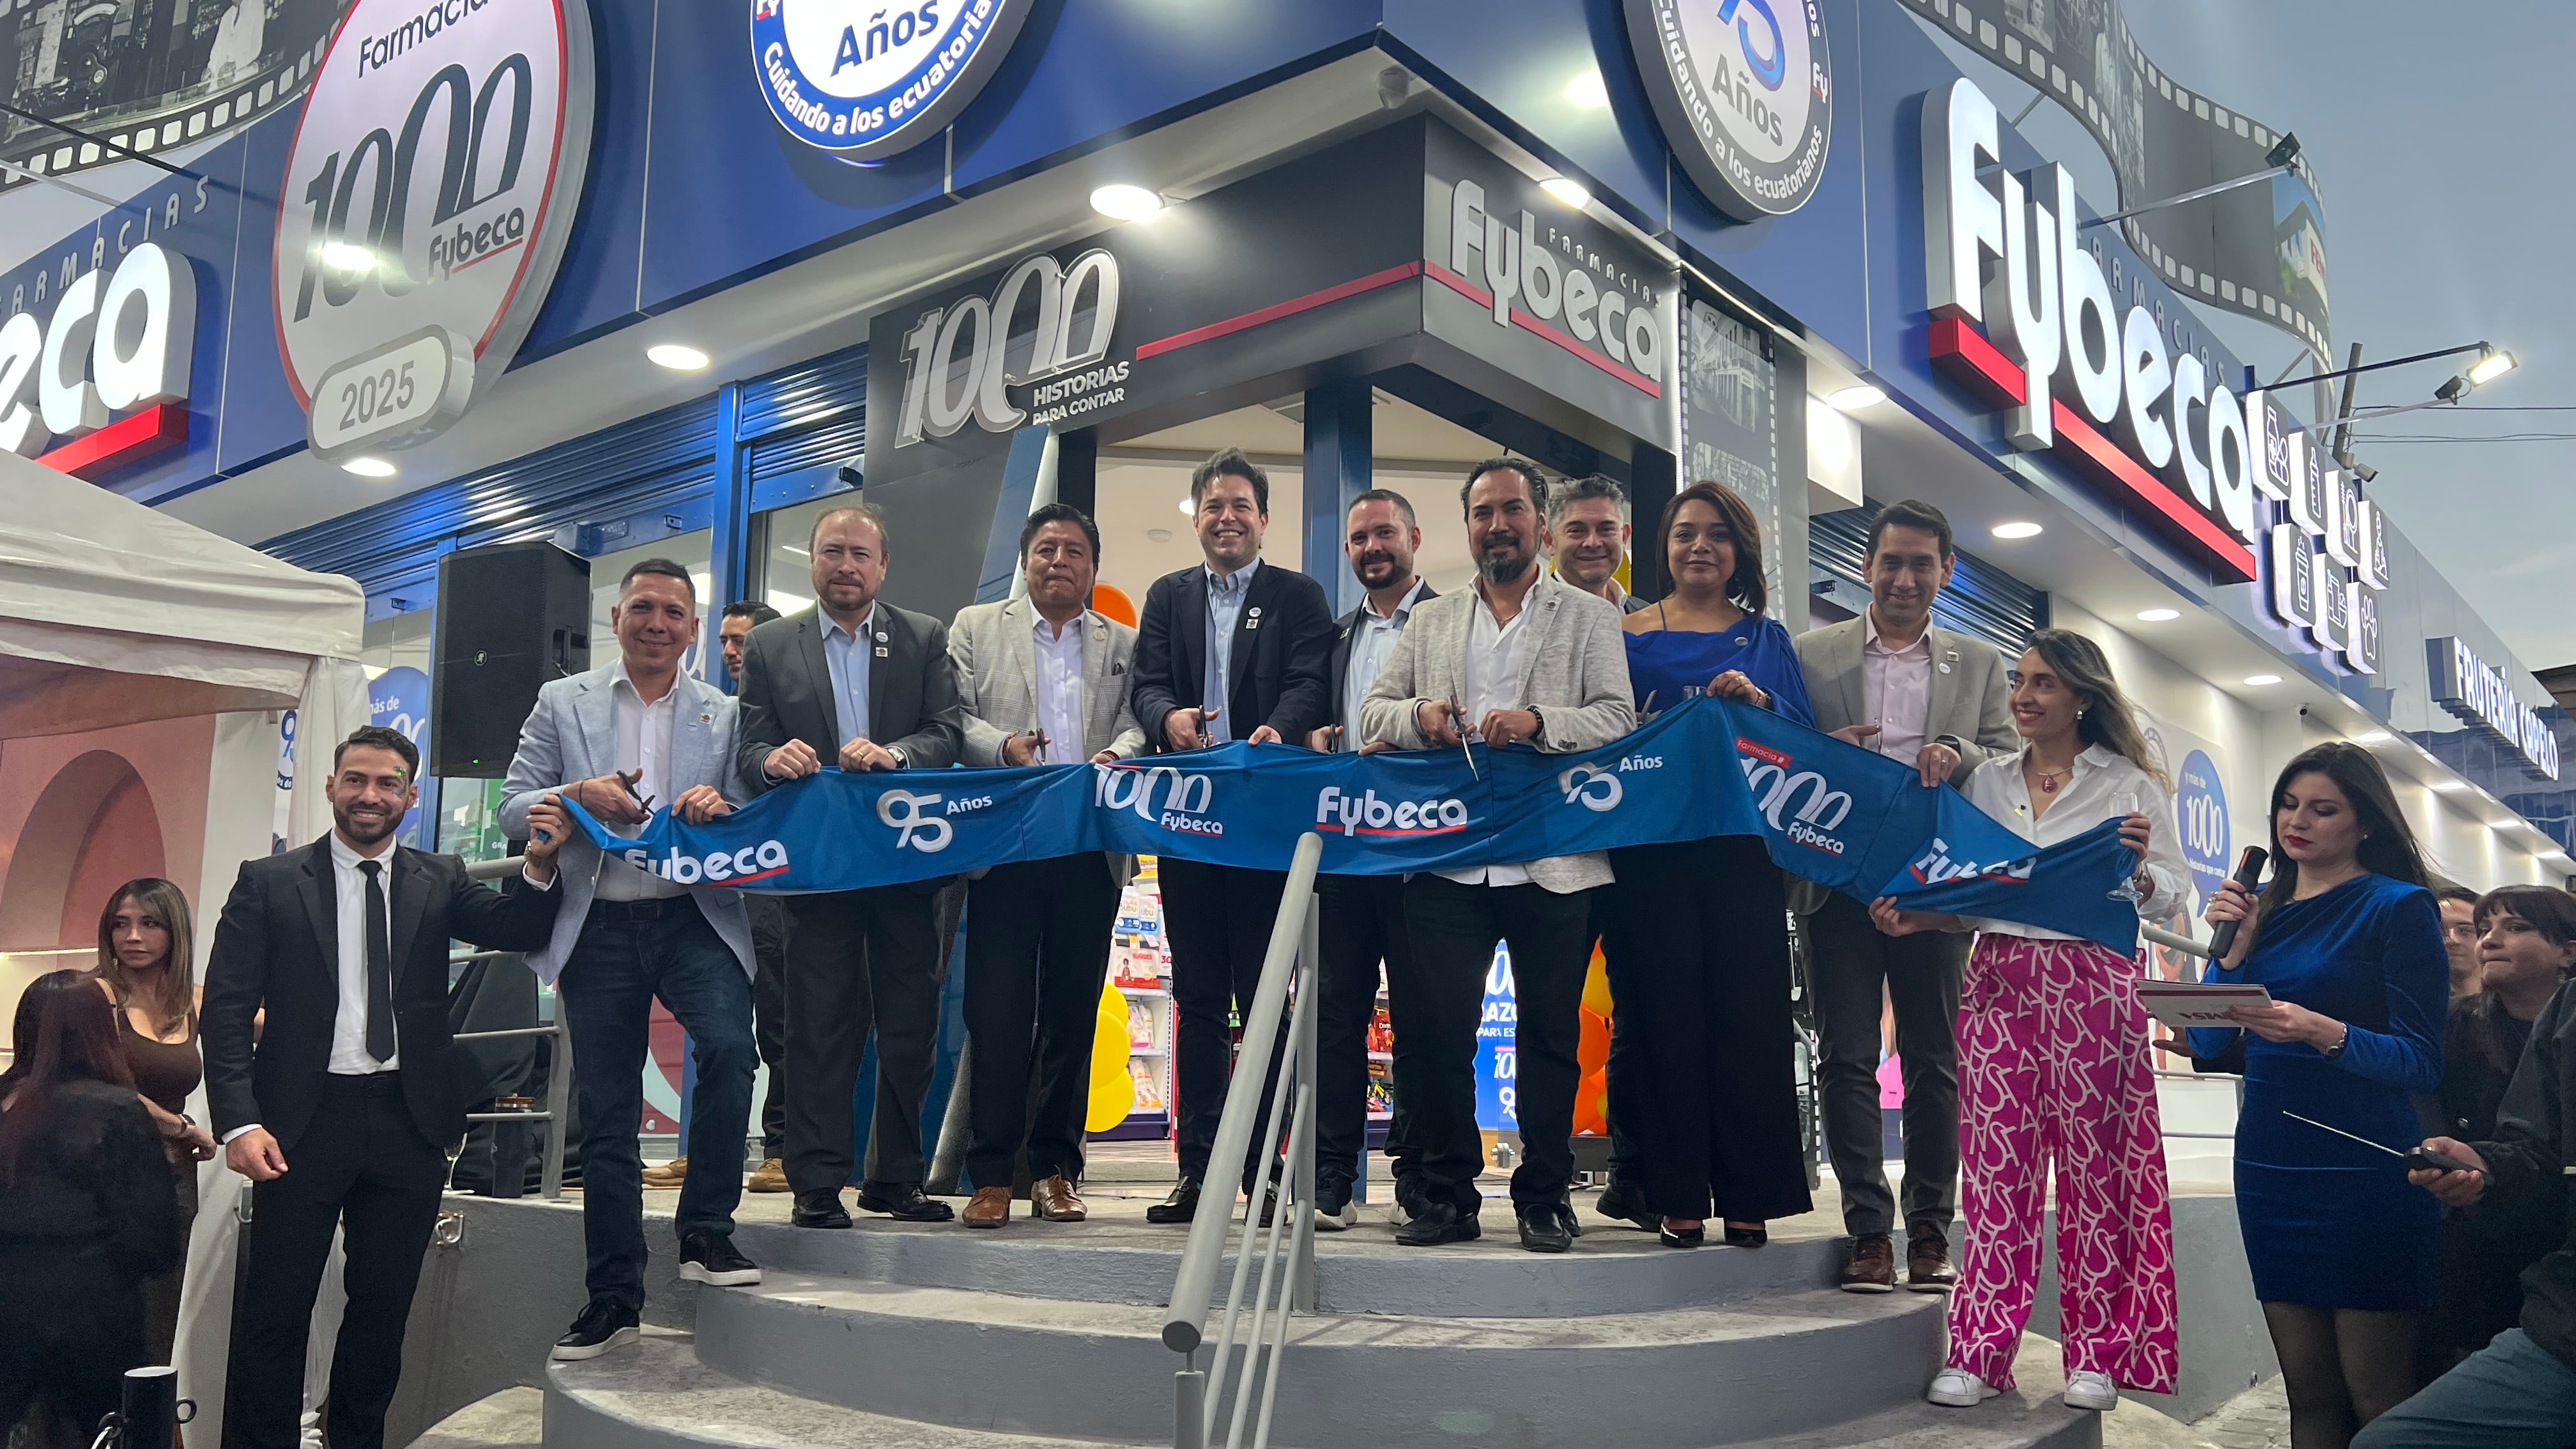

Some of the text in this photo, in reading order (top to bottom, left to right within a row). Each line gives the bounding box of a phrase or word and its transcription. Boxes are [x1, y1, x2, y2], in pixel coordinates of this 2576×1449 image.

[831, 0, 939, 78] Años
[764, 42, 831, 132] Cuidando
[832, 113, 848, 135] a
[849, 106, 884, 134] los
[1712, 53, 1783, 147] Años
[1813, 61, 1828, 104] Fy
[294, 52, 532, 323] 1000
[1715, 137, 1726, 160] a
[1729, 147, 1751, 187] los
[1754, 125, 1823, 200] ecuatorianos
[427, 207, 525, 281] Fybeca
[1548, 227, 1662, 309] FARMACIAS
[1451, 179, 1662, 383] Fybeca
[1945, 75, 2257, 546] Fybeca
[897, 249, 1118, 447] 1000
[339, 360, 415, 431] 2025
[1032, 360, 1130, 407] HISTORIAS
[1032, 387, 1124, 426] PARA CONTAR
[387, 696, 400, 712] de
[1618, 754, 1663, 774] Años
[1738, 739, 1785, 764] Farmacia #
[2184, 771, 2206, 789] y más de
[876, 789, 954, 853] 95
[946, 793, 993, 816] Años
[1094, 763, 1213, 822] 1000
[1160, 811, 1223, 835] Fybeca
[1317, 786, 1468, 837] Fybeca
[1787, 822, 1845, 854] Fybeca
[2186, 793, 2223, 858] 1000
[1477, 1027, 1502, 1038] PARA
